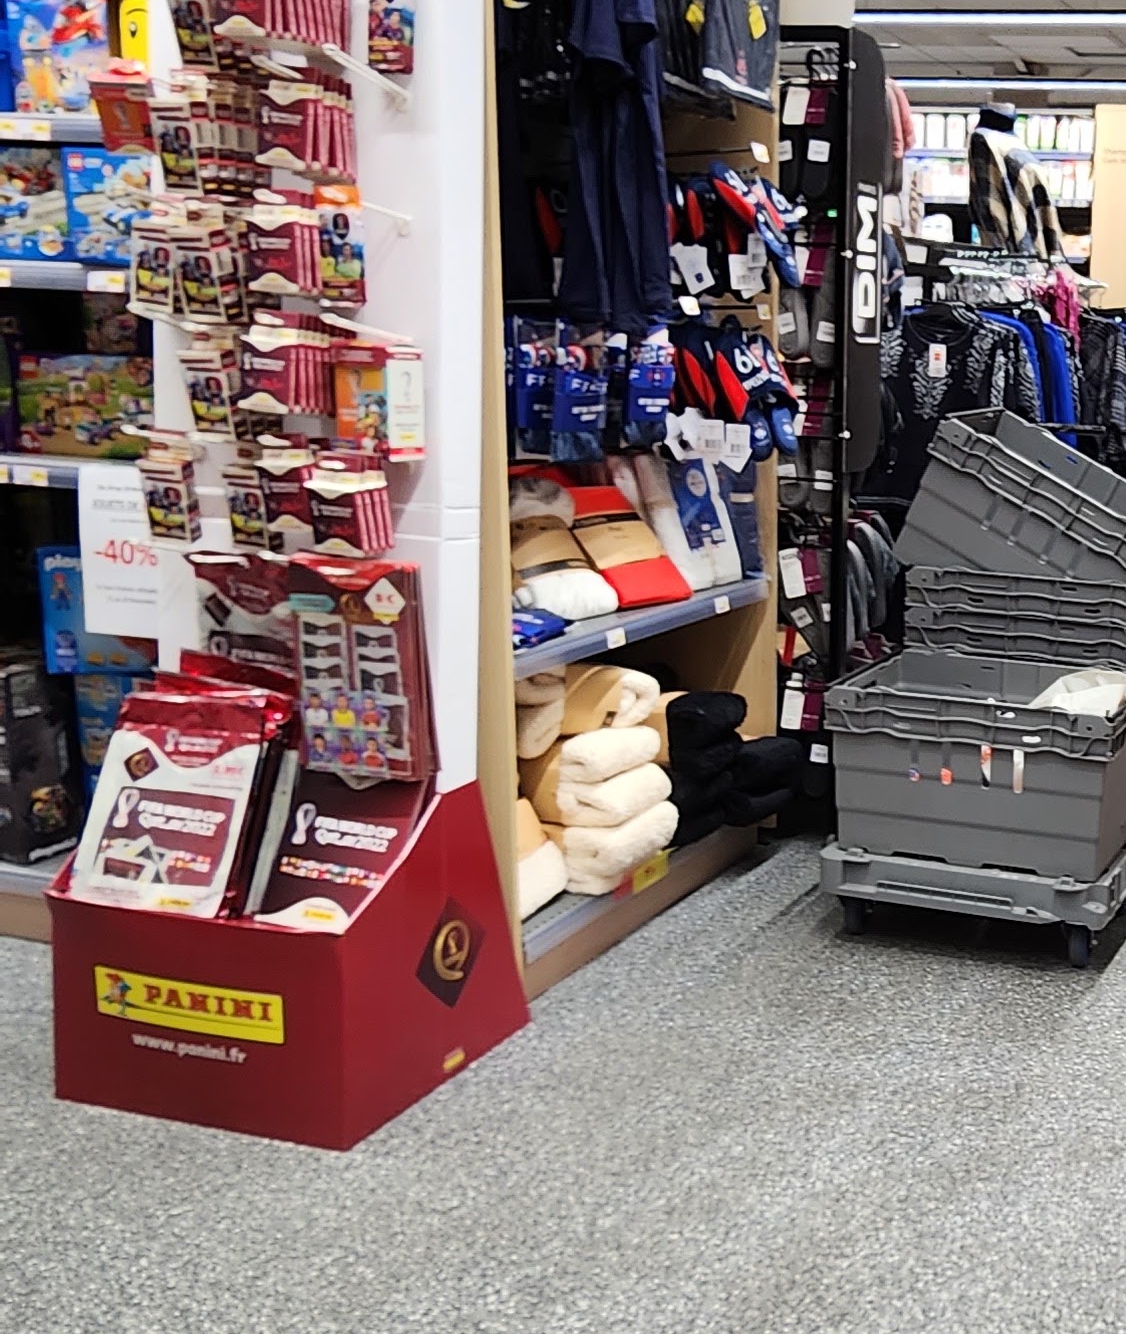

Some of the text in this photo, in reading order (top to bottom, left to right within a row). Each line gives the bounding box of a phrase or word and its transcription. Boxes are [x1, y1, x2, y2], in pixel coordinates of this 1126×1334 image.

[855, 193, 879, 318] DIM
[94, 540, 159, 566] -40%
[143, 982, 273, 1023] PANINI
[131, 1033, 247, 1065] www.panini.fr
